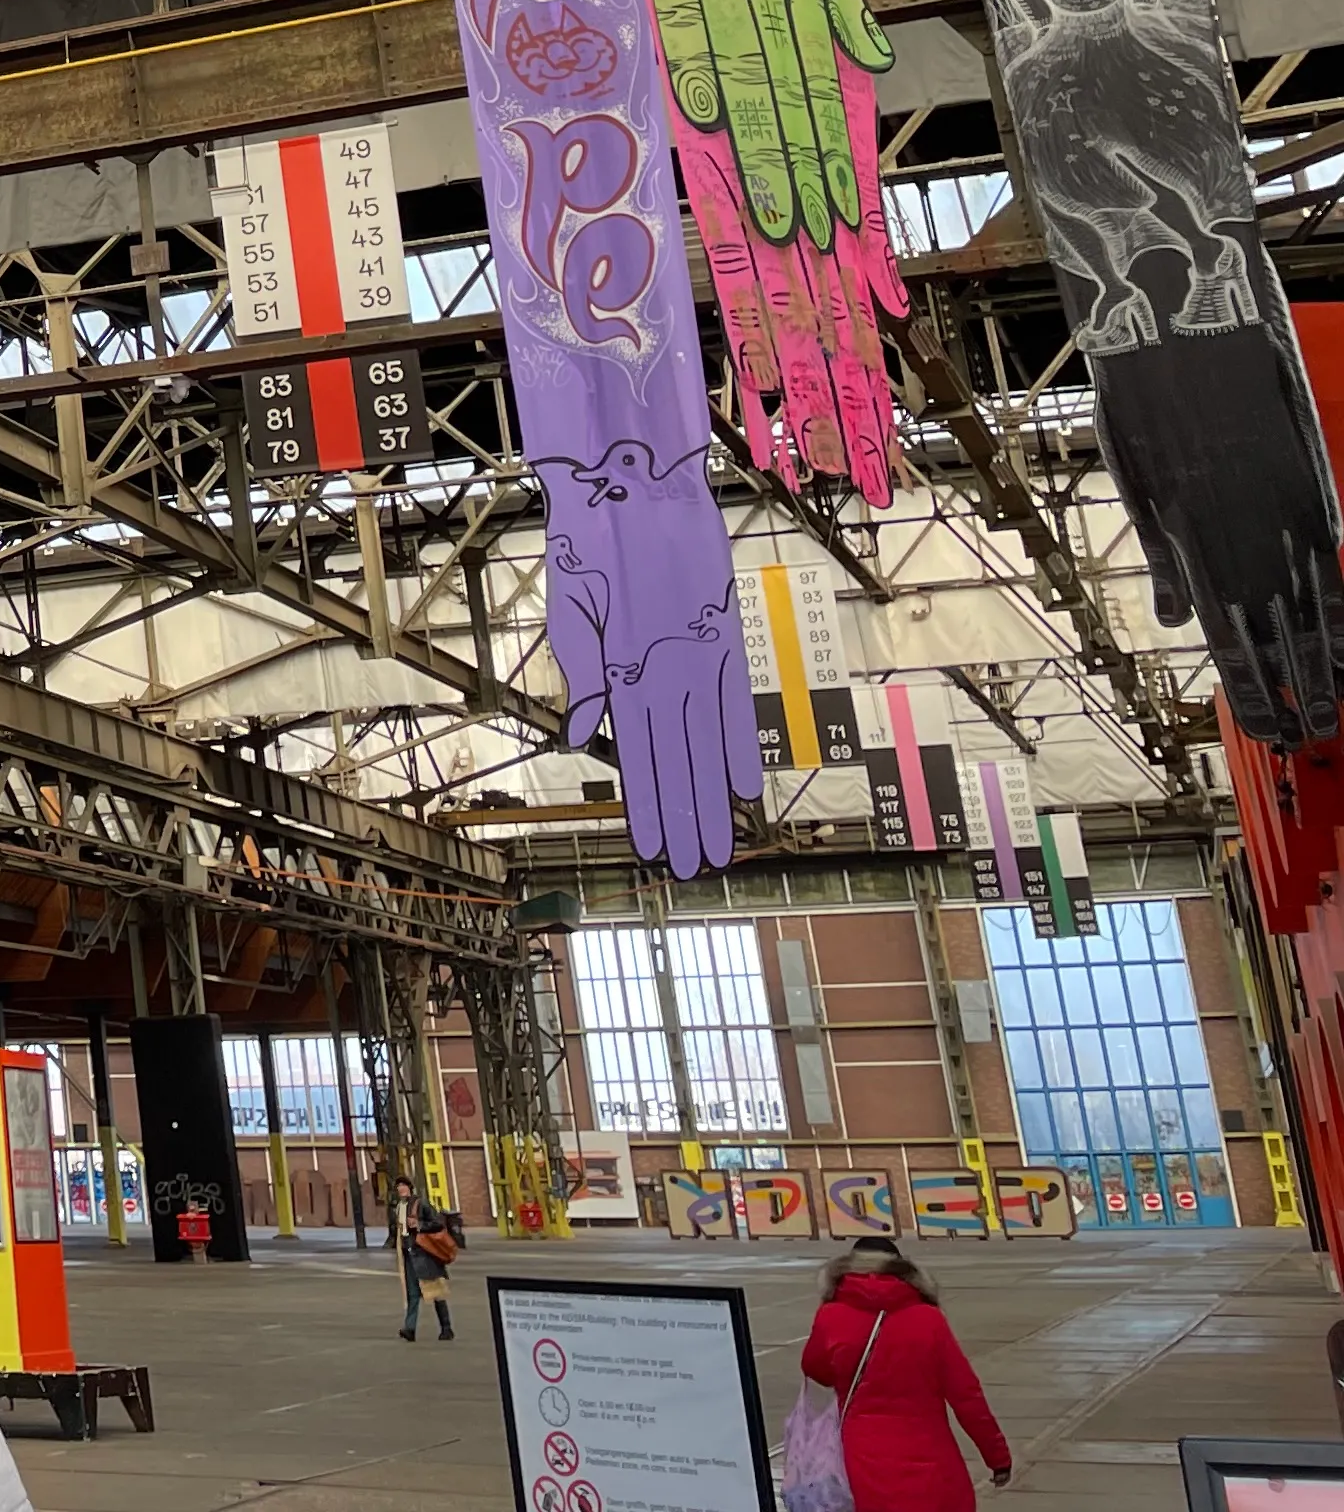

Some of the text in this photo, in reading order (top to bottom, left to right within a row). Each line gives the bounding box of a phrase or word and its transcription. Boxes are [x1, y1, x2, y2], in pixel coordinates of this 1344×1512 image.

[340, 139, 371, 160] 49
[345, 168, 372, 189] 47
[348, 197, 380, 218] 45
[241, 214, 267, 235] 57
[351, 226, 384, 247] 43
[244, 242, 275, 264] 55
[359, 257, 385, 277] 41
[247, 271, 278, 293] 53
[360, 286, 391, 308] 39
[254, 302, 280, 322] 51
[369, 360, 404, 385] 65
[260, 374, 292, 398] 83
[374, 394, 408, 418] 63
[266, 406, 293, 430] 81
[378, 427, 411, 451] 37
[267, 440, 300, 464] 79
[799, 571, 817, 584] 97
[803, 591, 822, 603] 93
[808, 611, 825, 623] 91
[810, 630, 830, 643] 89
[814, 650, 832, 662] 87
[816, 669, 837, 682] 59
[758, 729, 780, 744] 95
[828, 725, 847, 740] 71
[762, 749, 781, 764] 77
[879, 801, 899, 813] 117
[940, 814, 959, 827] 75
[884, 833, 907, 846] 113
[943, 831, 961, 843] 73
[599, 1098, 736, 1119] PALESINE
